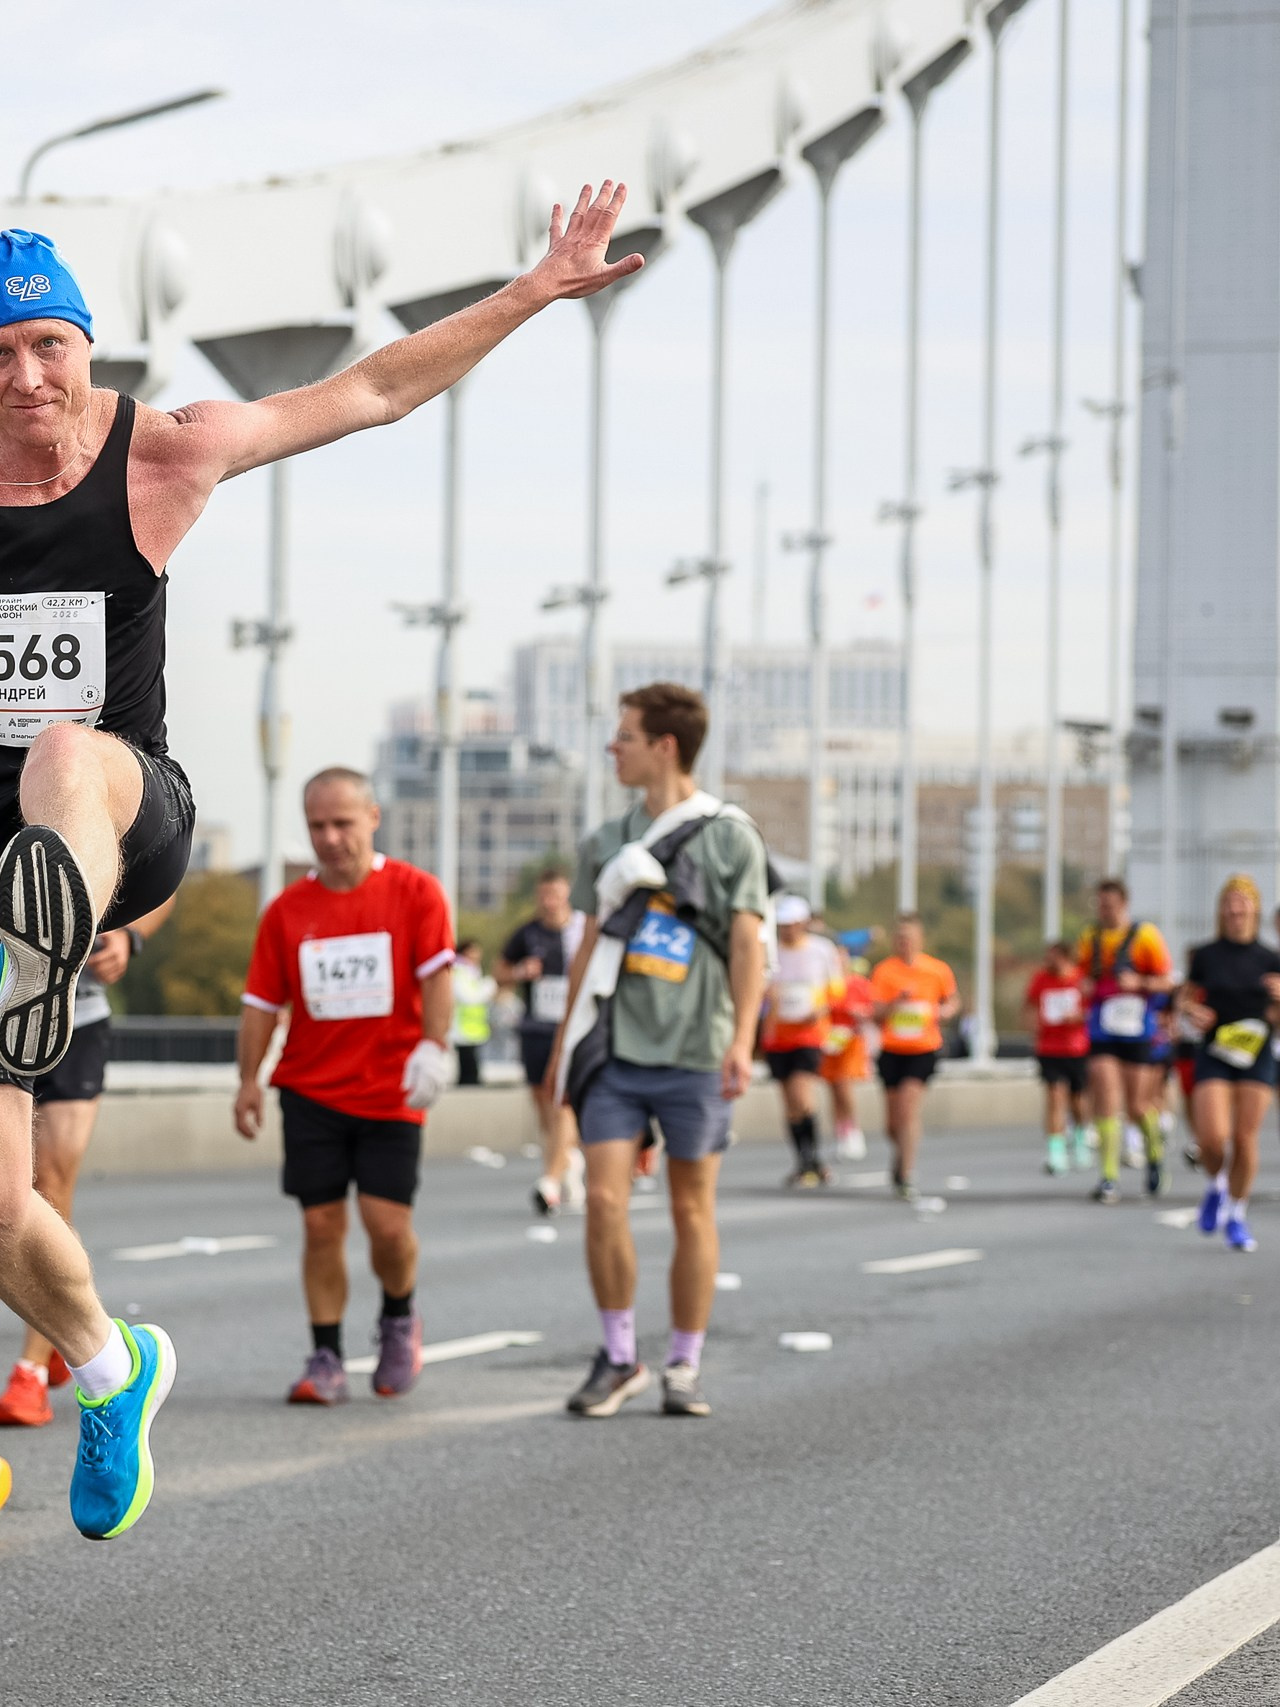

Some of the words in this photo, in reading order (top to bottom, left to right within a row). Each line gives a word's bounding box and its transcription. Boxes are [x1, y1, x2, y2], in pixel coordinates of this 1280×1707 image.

[47, 599, 66, 607] 42,2
[86, 690, 94, 698] 8
[317, 954, 378, 983] 1479
